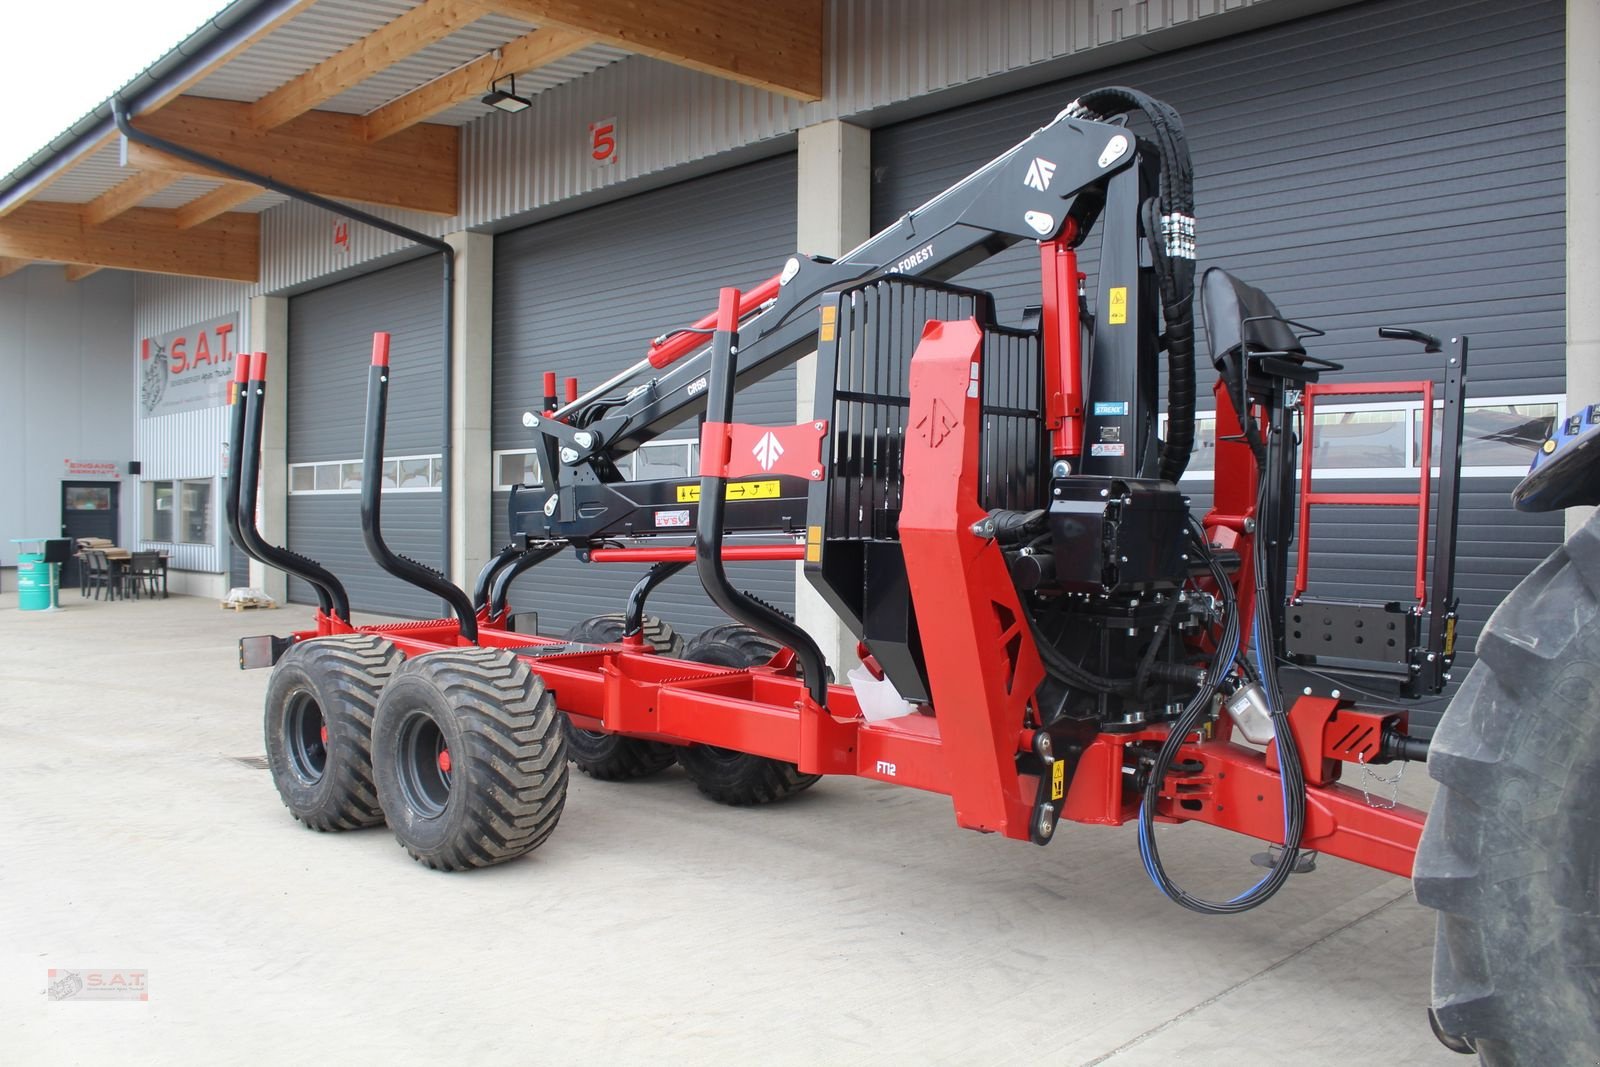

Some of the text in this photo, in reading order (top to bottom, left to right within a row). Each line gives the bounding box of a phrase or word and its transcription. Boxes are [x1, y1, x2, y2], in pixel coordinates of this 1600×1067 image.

[592, 125, 614, 160] 5
[335, 223, 348, 247] 4
[898, 244, 934, 274] FOREST
[170, 323, 233, 375] S.A.T.
[876, 760, 897, 777] FT12
